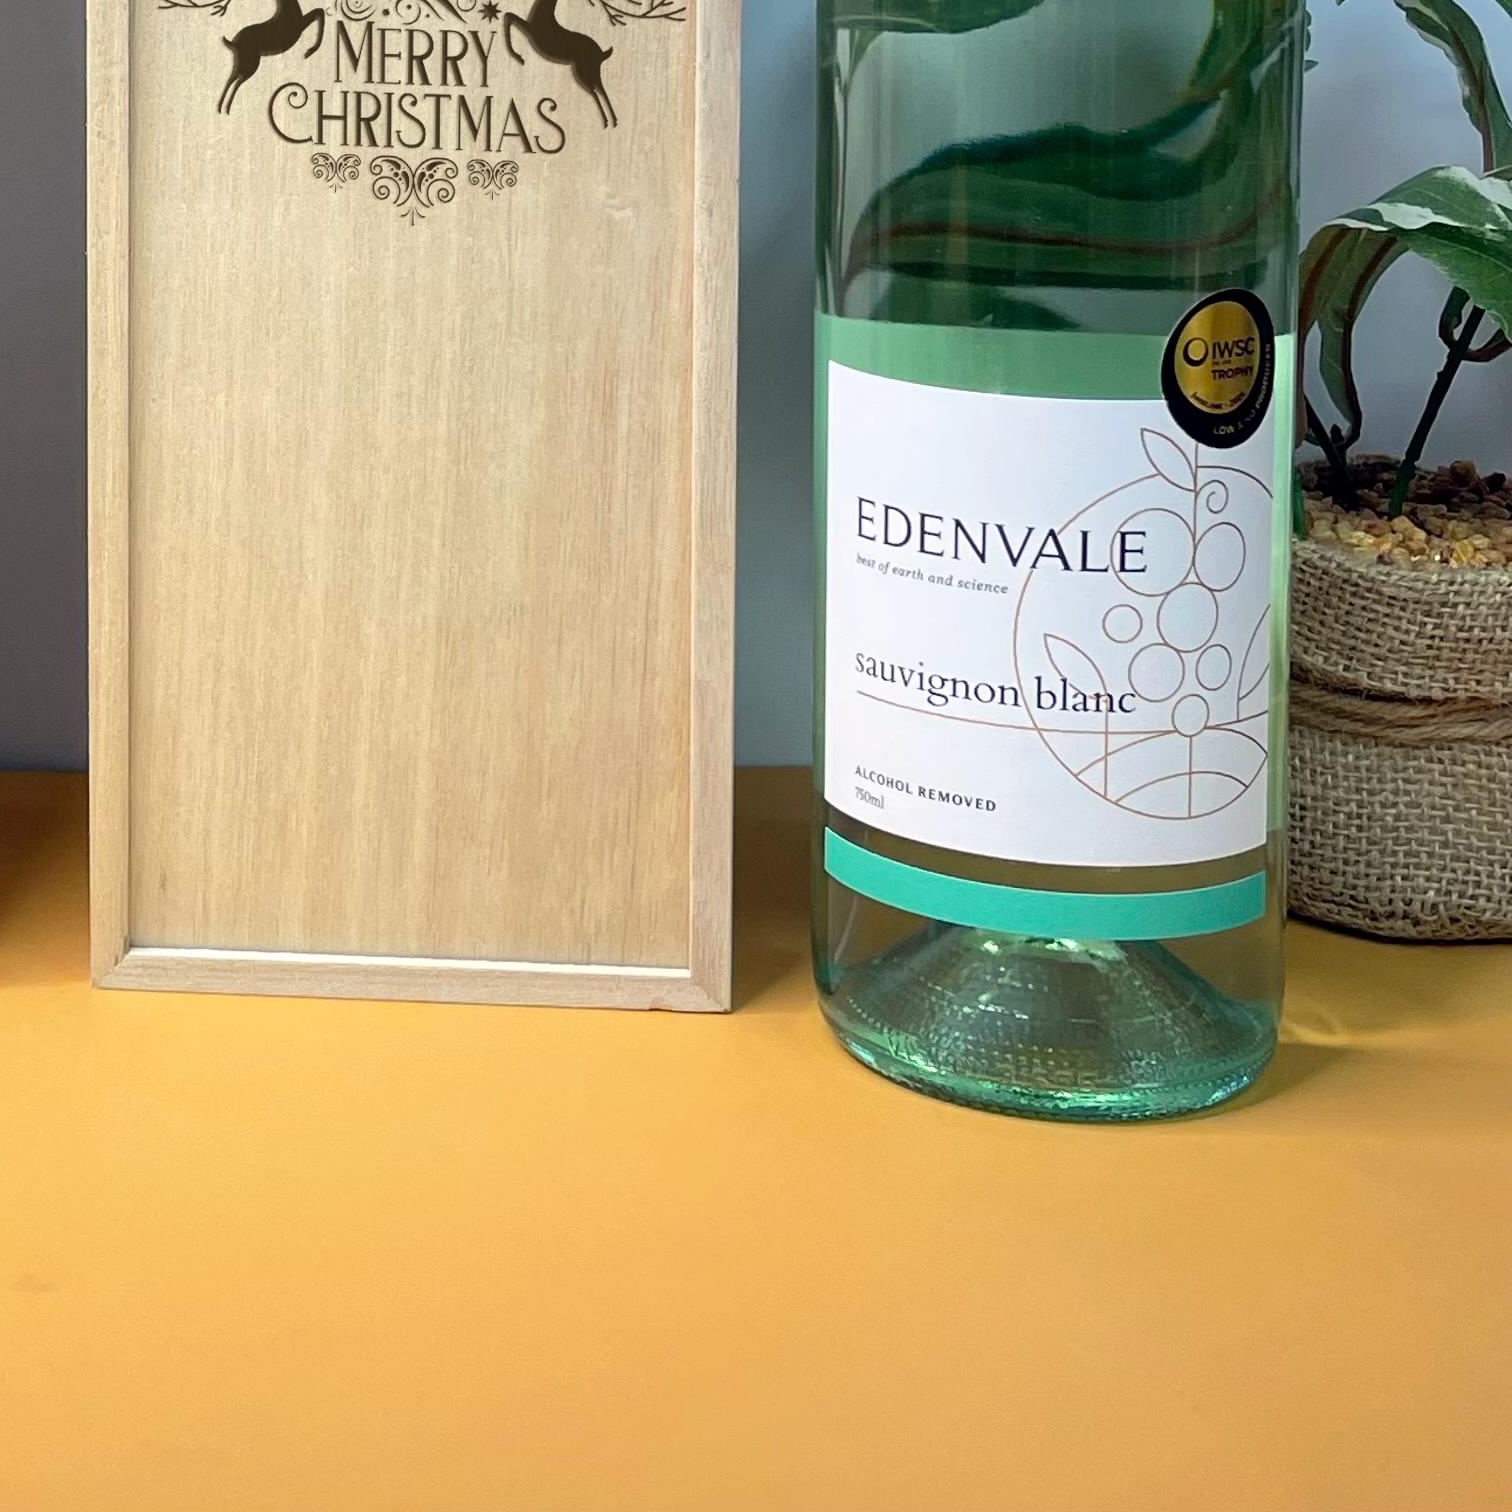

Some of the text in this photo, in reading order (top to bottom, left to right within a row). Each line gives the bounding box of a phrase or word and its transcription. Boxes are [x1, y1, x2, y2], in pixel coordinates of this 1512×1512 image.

[334, 20, 498, 88] MERRY
[268, 82, 566, 155] CHRISTMAS
[1212, 336, 1256, 360] IWSC
[1210, 365, 1254, 381] TROPHY
[857, 496, 1148, 573] EDENVALE
[856, 551, 1009, 594] best of earth and science
[855, 652, 1137, 713] sauvignon blanc
[854, 765, 996, 812] ALCOHOL REMOVED
[854, 786, 885, 809] 750ml
